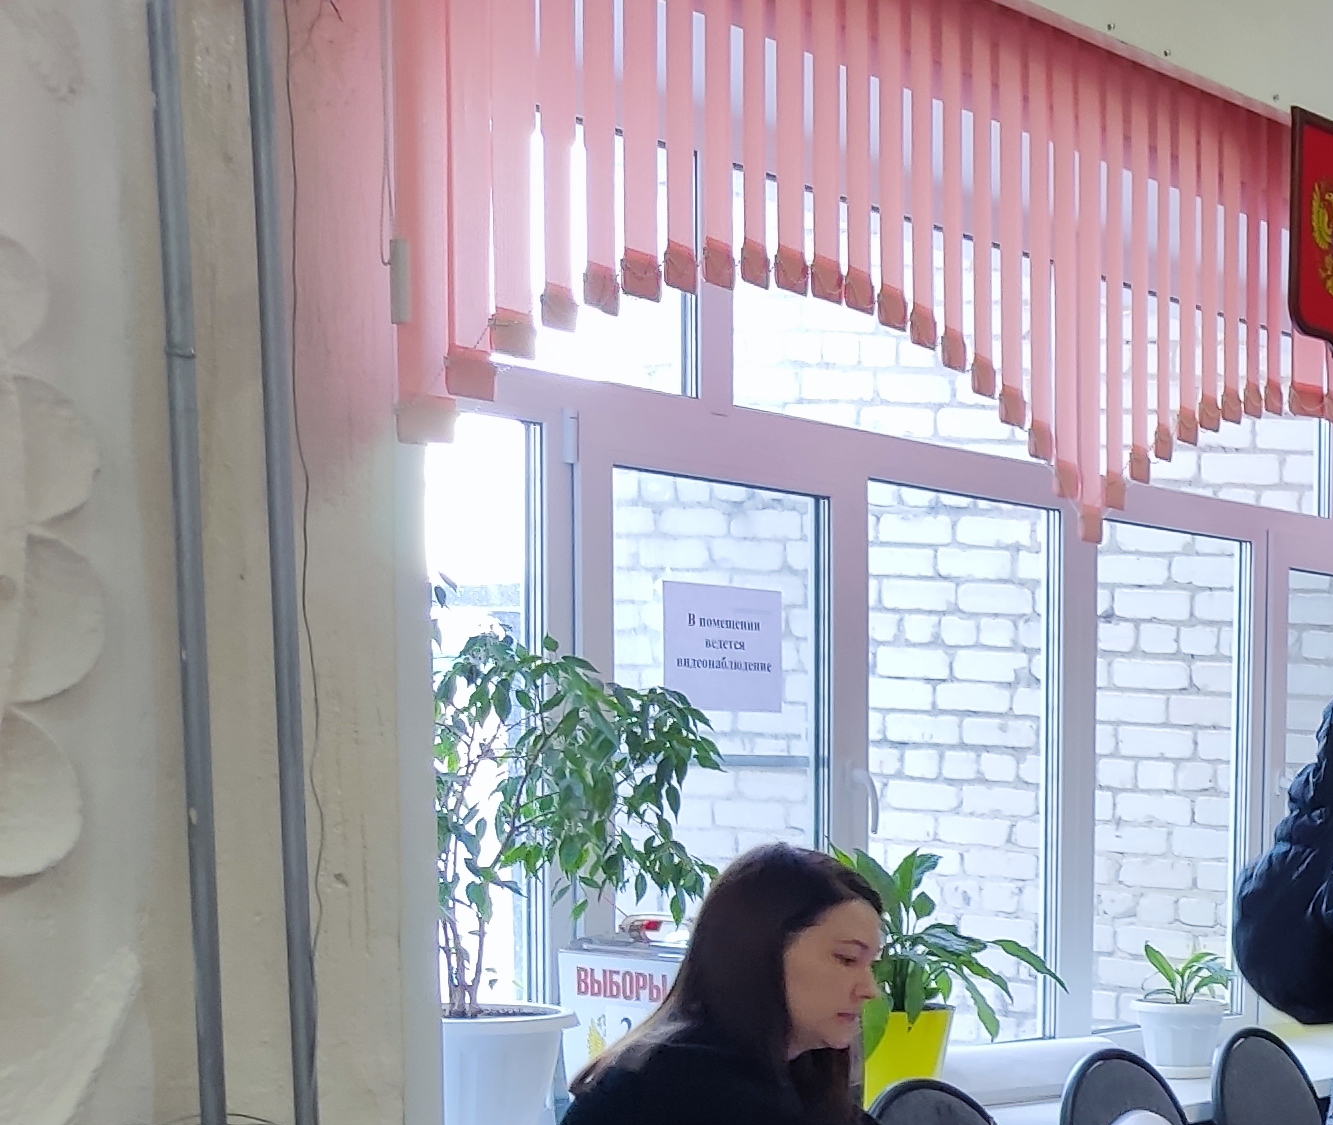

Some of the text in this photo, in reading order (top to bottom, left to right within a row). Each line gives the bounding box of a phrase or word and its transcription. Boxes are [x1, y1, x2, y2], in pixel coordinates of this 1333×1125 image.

[688, 612, 761, 632] В помещении
[705, 638, 746, 651] ведется
[677, 656, 773, 673] видеонаблюдение
[576, 966, 668, 1003] ВЫБОРЫ
